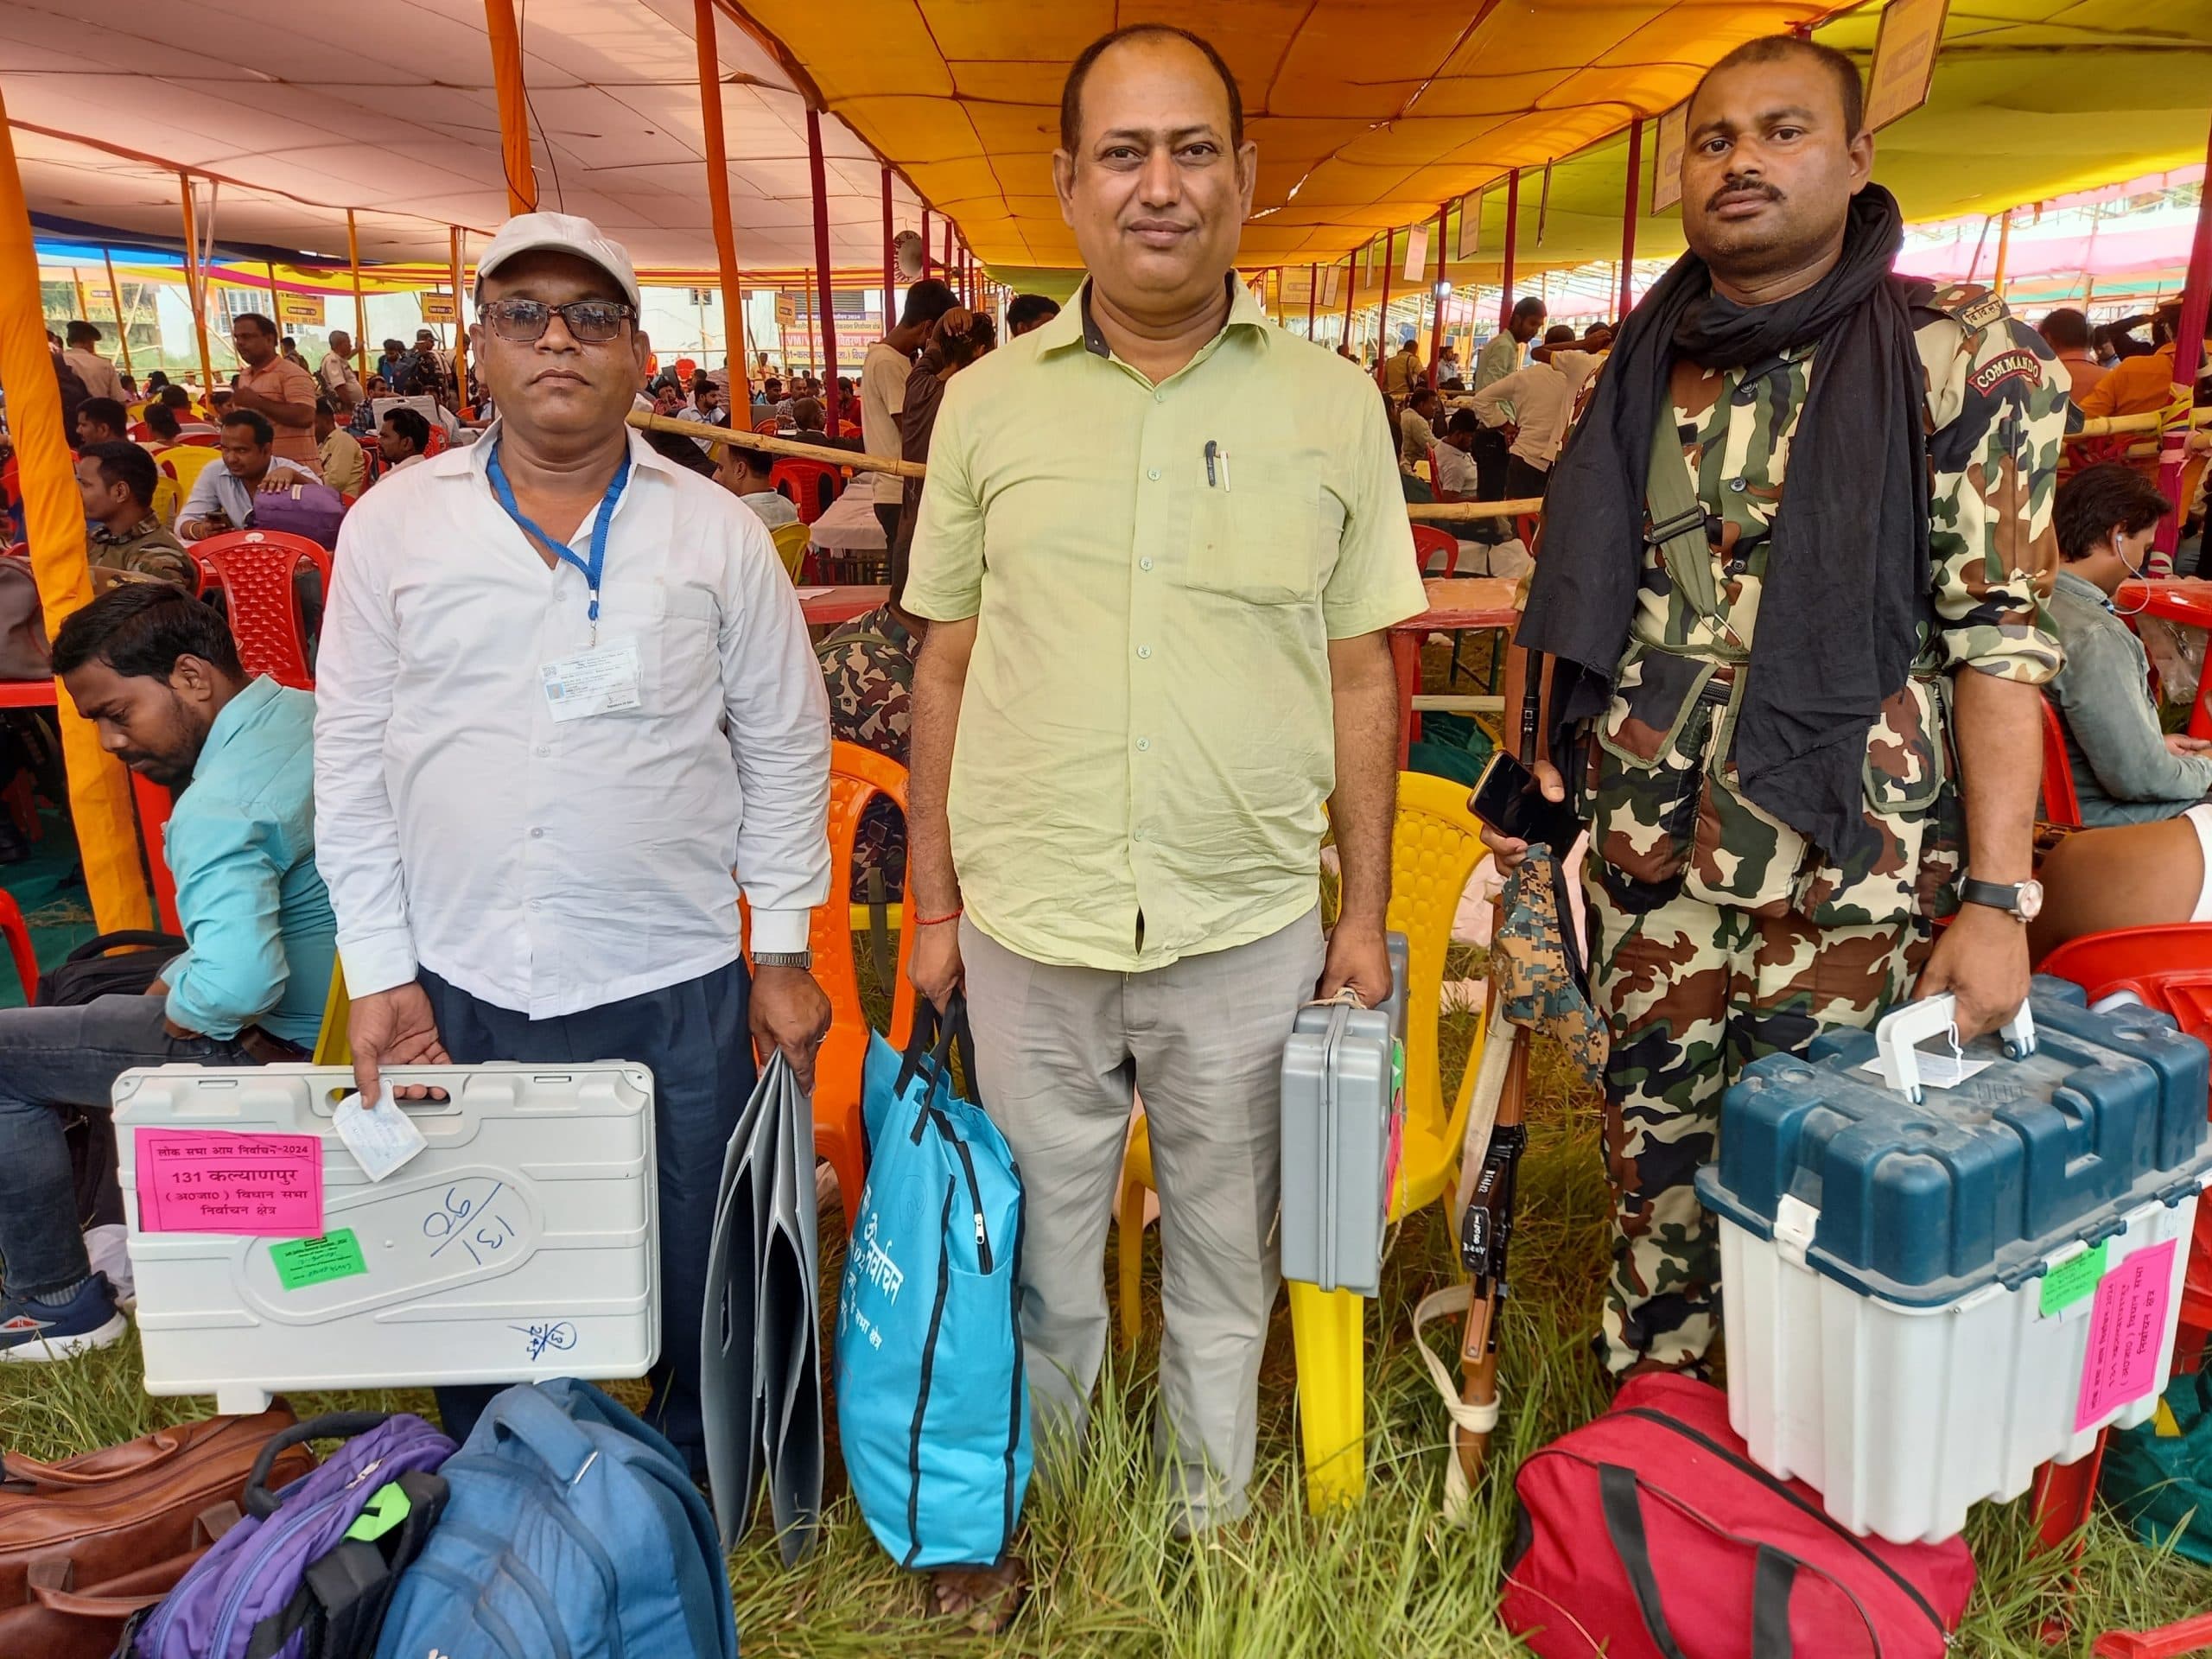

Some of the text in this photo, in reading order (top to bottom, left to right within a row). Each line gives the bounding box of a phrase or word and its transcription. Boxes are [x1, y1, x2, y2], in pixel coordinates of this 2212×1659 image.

[1977, 356, 2038, 388] COMMANDO
[157, 1147, 181, 1157] लोक
[187, 1147, 207, 1157] सभा
[213, 1147, 233, 1155] आम
[173, 1170, 298, 1185] 131 कल्याणपुर
[236, 1189, 274, 1199] विधान
[282, 1190, 308, 1199] सभा
[200, 1203, 276, 1216] निर्वाचन क्षेत्र
